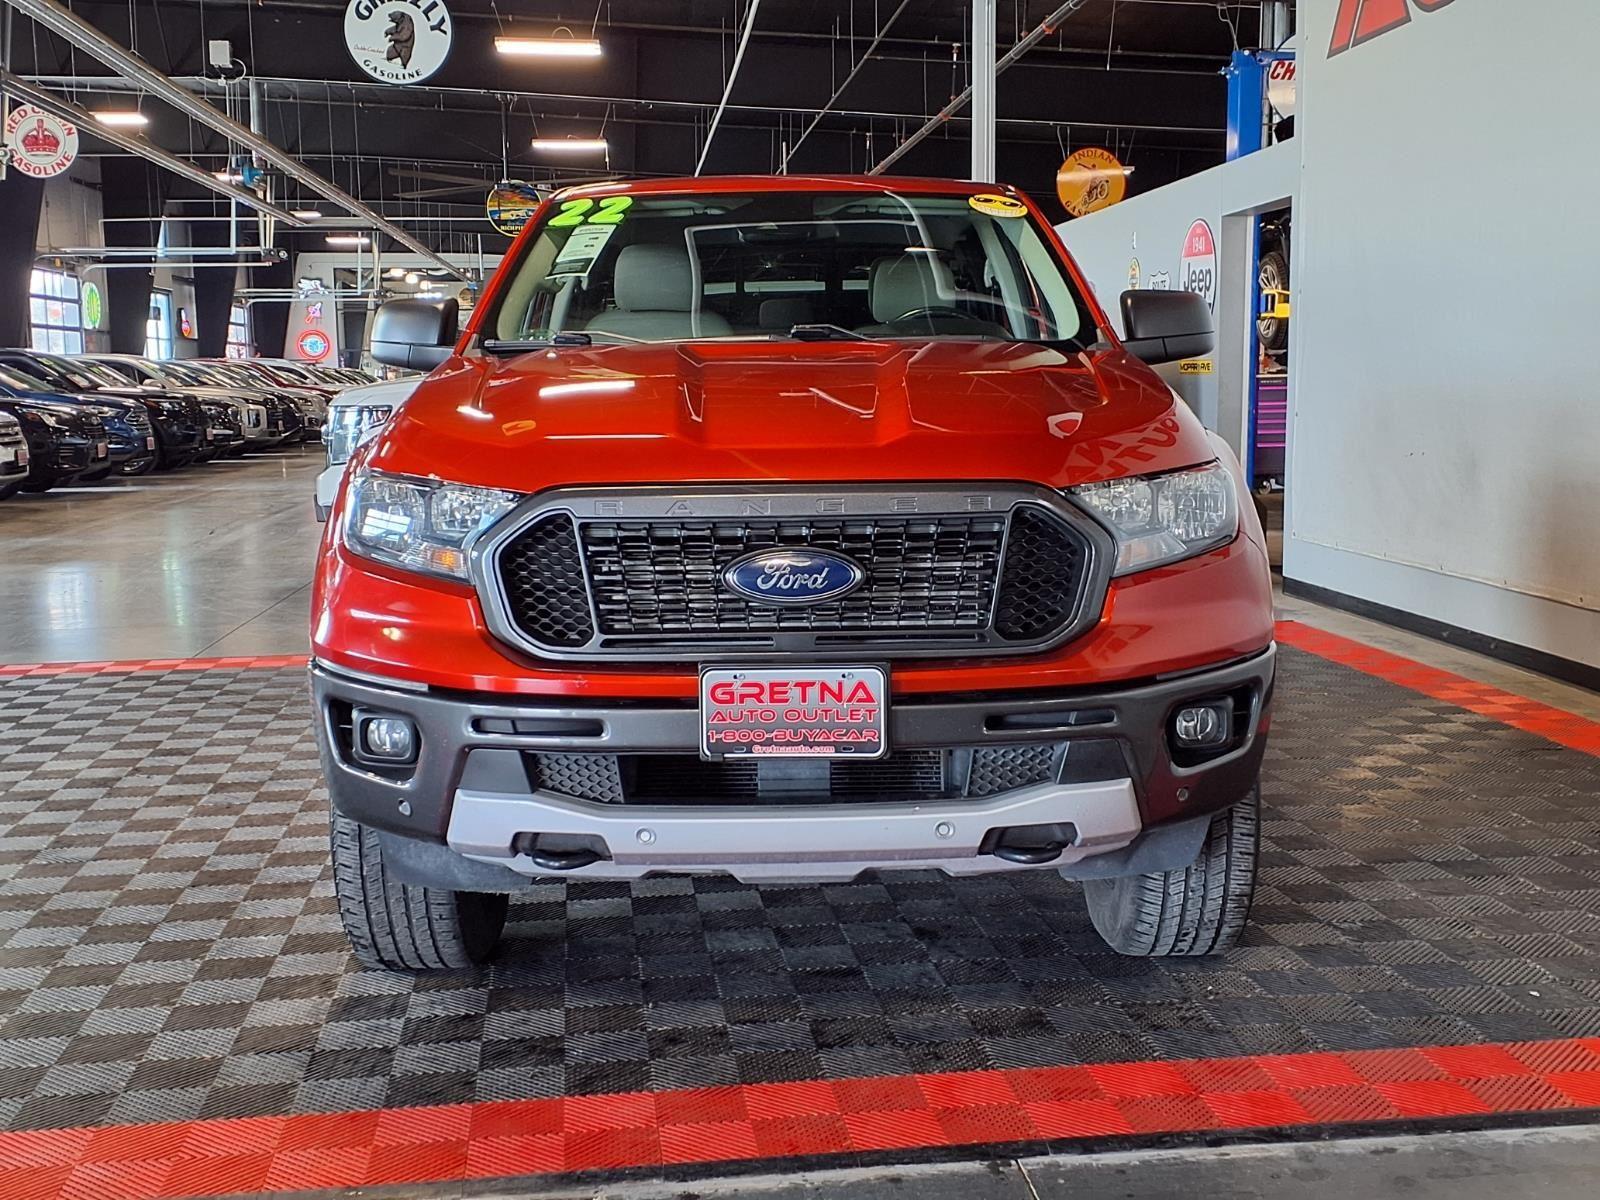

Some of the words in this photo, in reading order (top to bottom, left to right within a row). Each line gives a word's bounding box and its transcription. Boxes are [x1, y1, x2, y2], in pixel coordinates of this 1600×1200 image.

[363, 59, 423, 80] GASOLINE
[7, 108, 28, 134] RED
[1073, 150, 1114, 164] INDIAN
[548, 196, 633, 226] 22
[1184, 262, 1212, 299] Jeep
[594, 495, 992, 515] RANGER
[757, 558, 830, 590] Ford
[709, 680, 878, 706] GRETNA
[709, 709, 778, 723] AUTO
[783, 708, 878, 723] OUTLET
[708, 729, 879, 743] 1-800-BUYACAR
